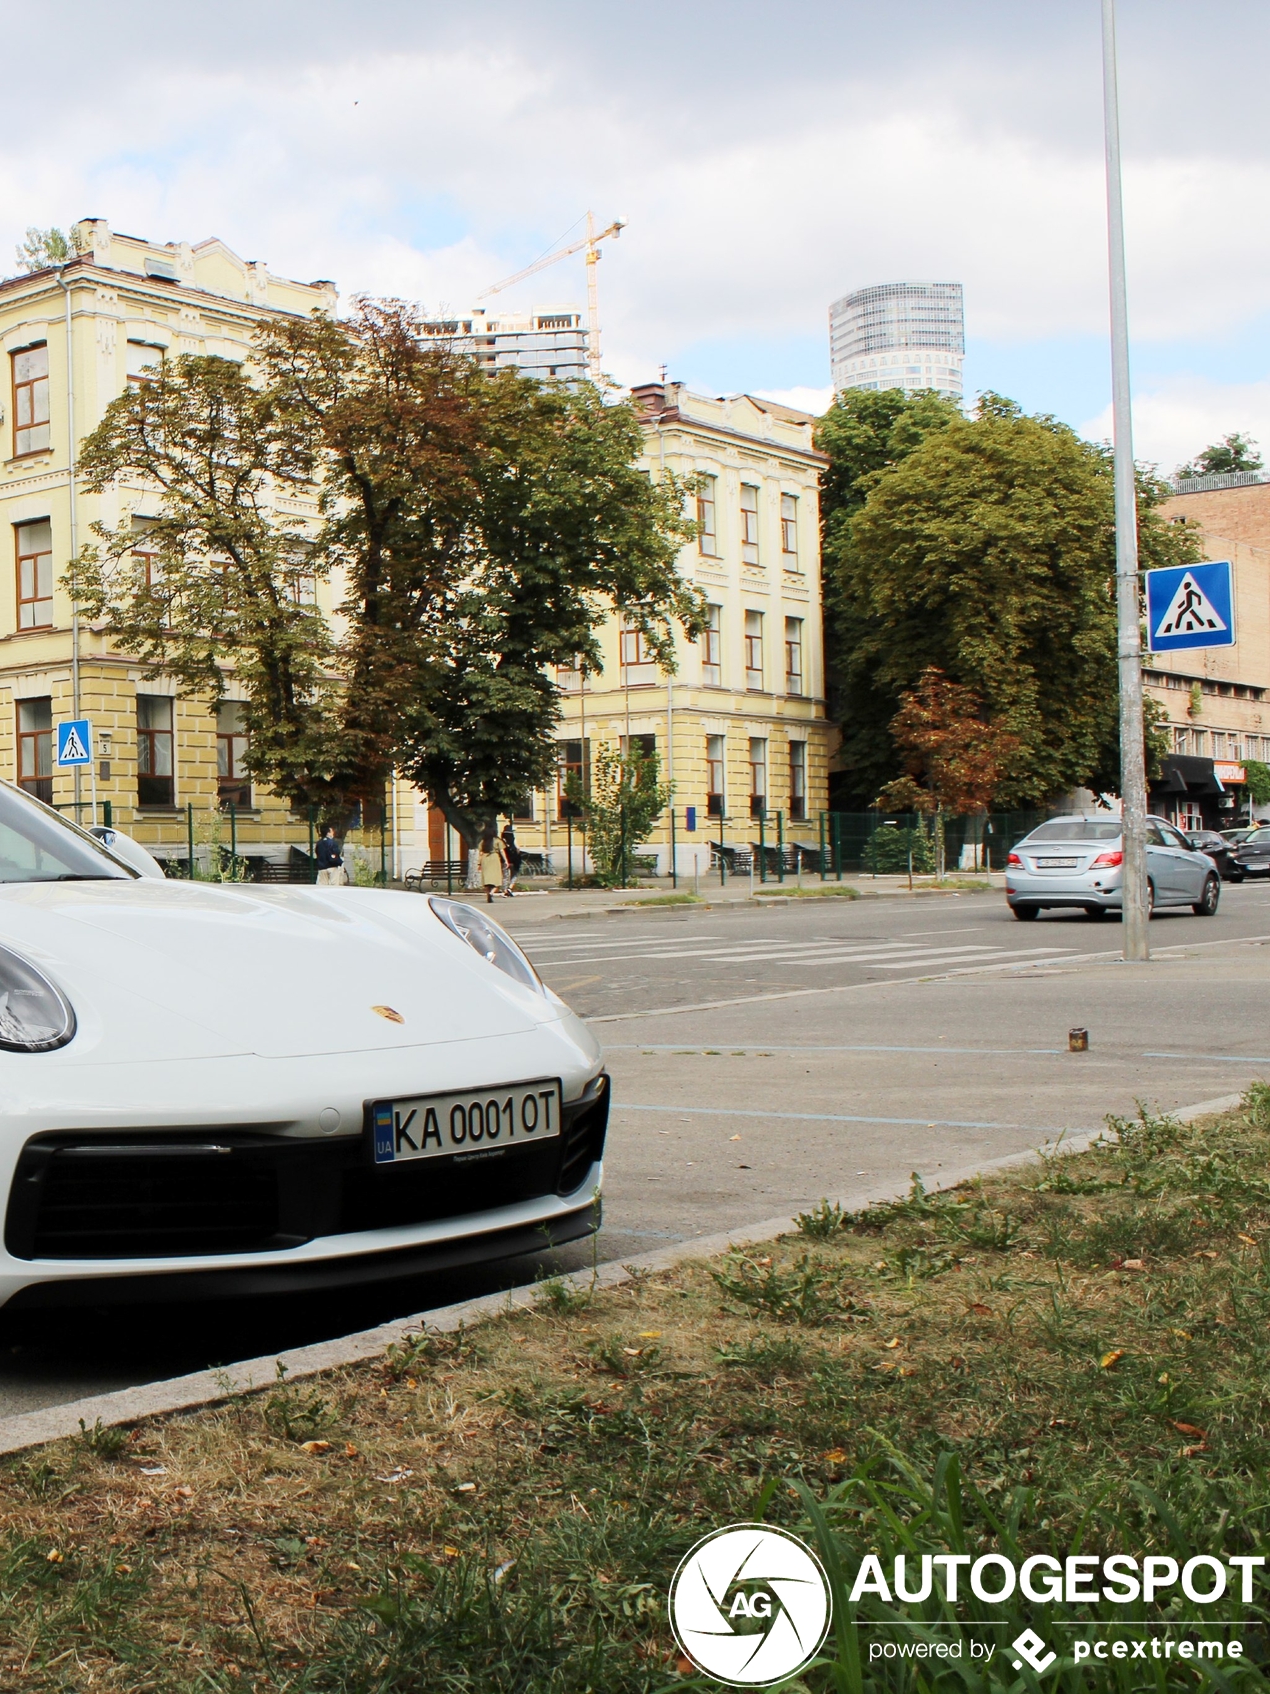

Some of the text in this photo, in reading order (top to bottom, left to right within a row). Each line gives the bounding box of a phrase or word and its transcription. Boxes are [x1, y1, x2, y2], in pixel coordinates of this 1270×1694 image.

[395, 1089, 555, 1153] KA 0001 OT
[377, 1141, 392, 1154] UA
